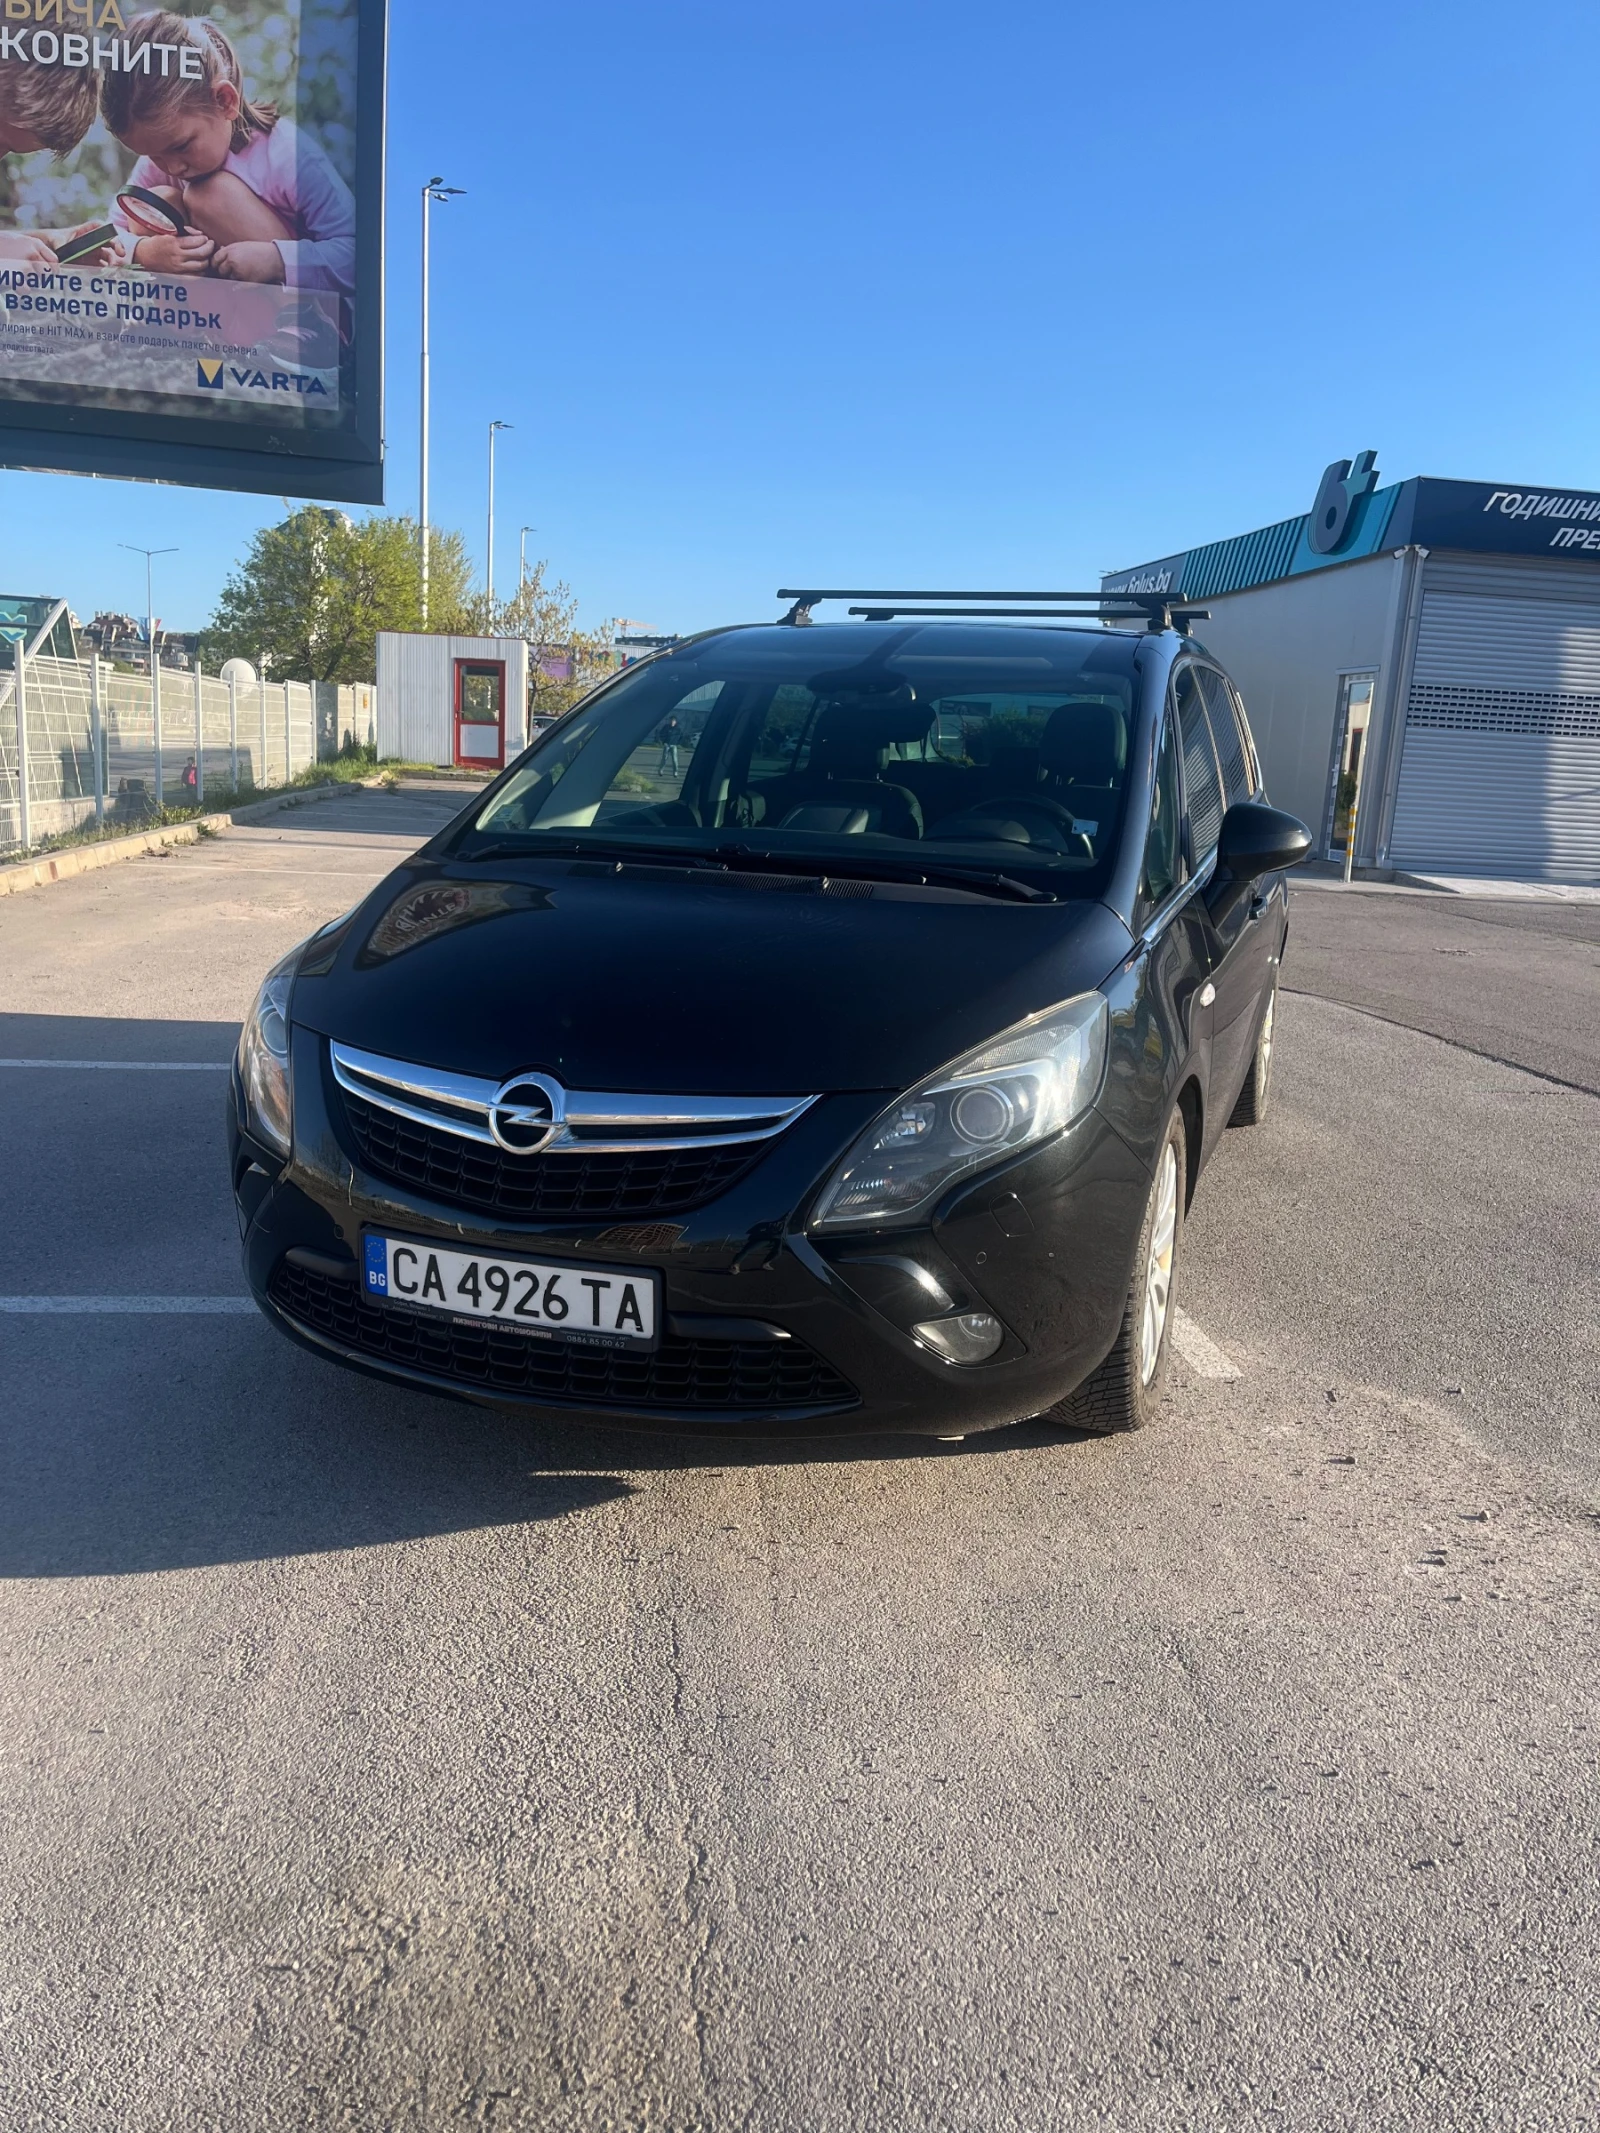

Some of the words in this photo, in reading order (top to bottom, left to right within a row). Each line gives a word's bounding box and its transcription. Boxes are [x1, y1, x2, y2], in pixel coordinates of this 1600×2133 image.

[0, 267, 82, 292] ирайте
[91, 277, 187, 302] старите
[5, 293, 108, 317] вземете
[116, 303, 222, 329] подарък
[39, 326, 45, 335] в
[47, 325, 62, 336] HIT
[64, 327, 86, 339] MAX
[87, 331, 94, 340] и
[96, 332, 136, 344] вземете
[138, 335, 179, 349] подарък
[181, 340, 220, 353] пакетче
[229, 367, 327, 395] VARTA
[1548, 527, 1600, 550] ПРЕ
[369, 1270, 386, 1287] BG
[393, 1247, 446, 1302] CA
[457, 1262, 569, 1320] 4926
[581, 1278, 644, 1332] TA
[499, 1325, 552, 1339] АВТОМОБИЛИ
[566, 1334, 587, 1344] 0886
[602, 1339, 613, 1347] 00
